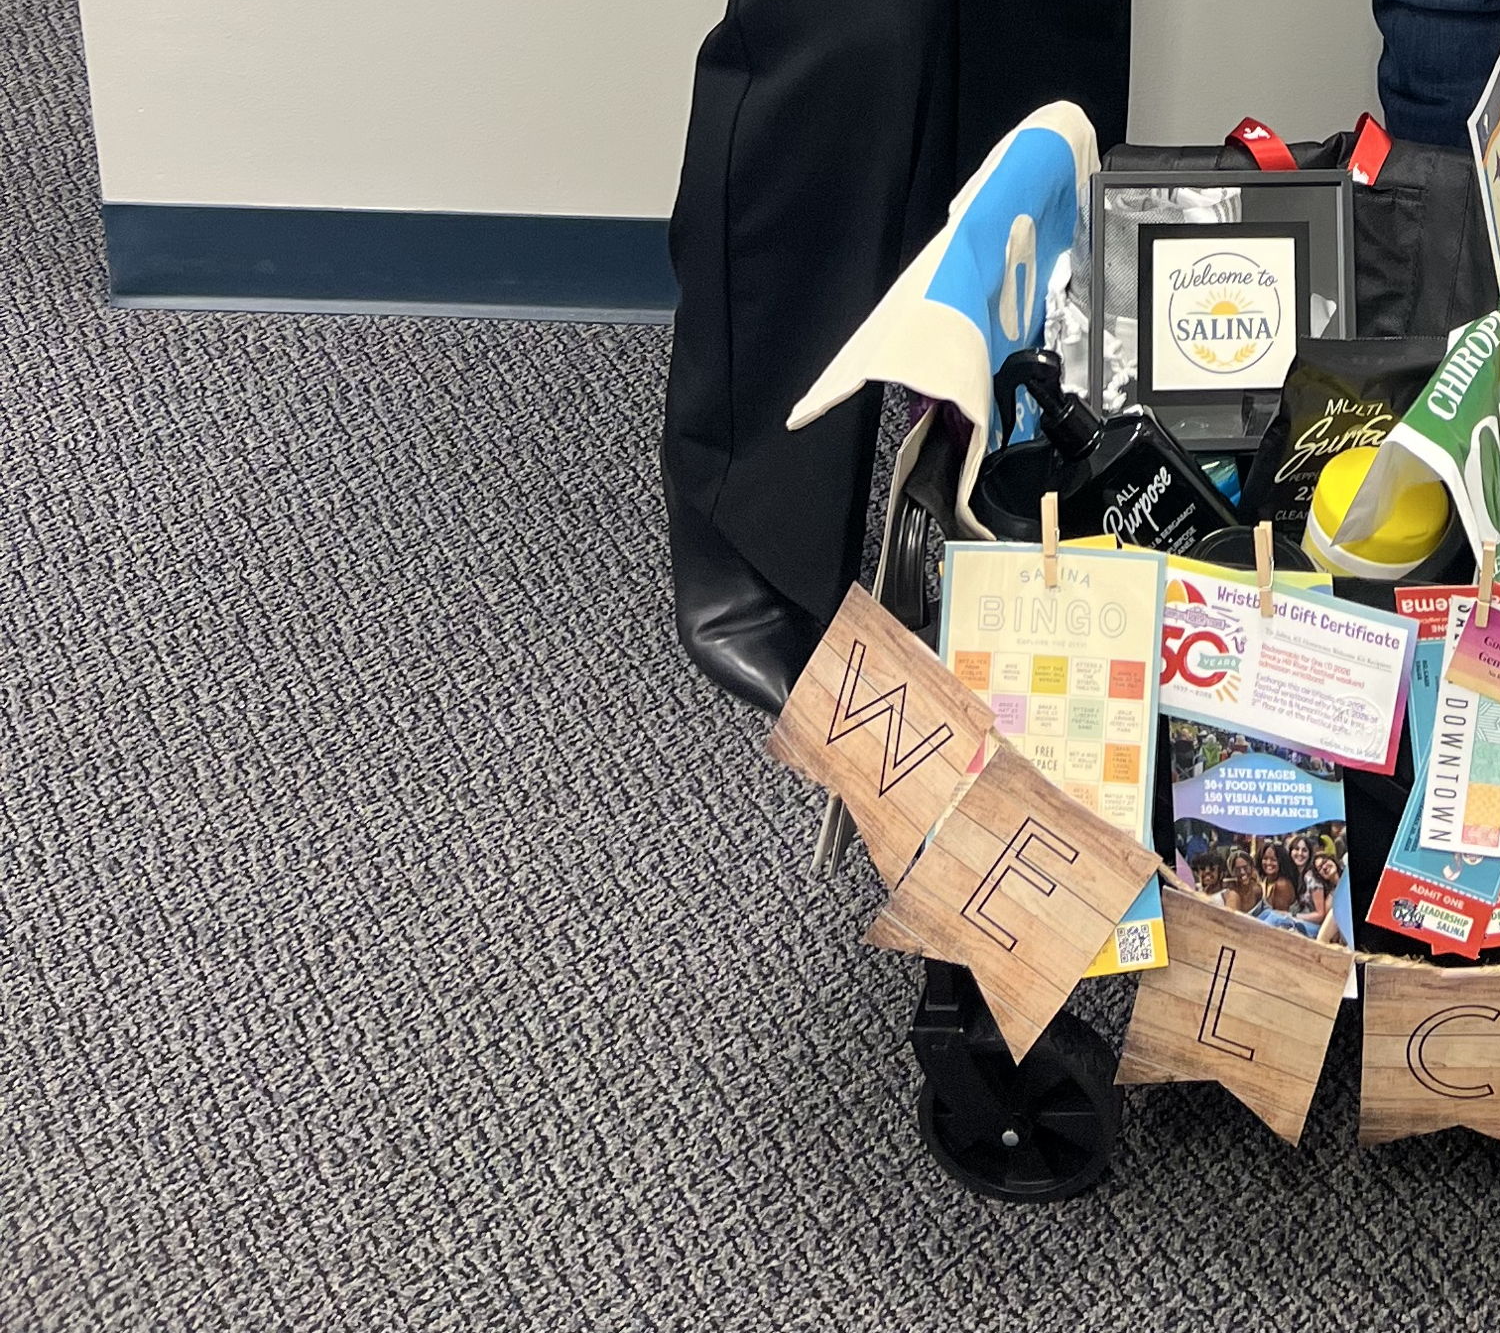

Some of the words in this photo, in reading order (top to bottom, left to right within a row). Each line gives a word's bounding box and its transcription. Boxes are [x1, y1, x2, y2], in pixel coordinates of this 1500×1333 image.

[1169, 263, 1253, 290] Welcome
[1258, 269, 1277, 286] to
[1177, 318, 1273, 341] SALINA
[1324, 399, 1383, 416] MULTI
[1274, 415, 1393, 483] Surfa
[1116, 484, 1140, 506] ALL
[1103, 466, 1171, 549] Purpose
[1160, 503, 1196, 538] BERGAMOT
[1020, 568, 1090, 588] SAINA
[978, 595, 1128, 639] BINGO
[1217, 586, 1286, 617] Wristbnd
[1290, 605, 1317, 626] Gift
[1320, 614, 1400, 650] Certificate
[1035, 746, 1054, 758] FREE
[1219, 768, 1225, 777] 3
[1228, 768, 1253, 779] LIVE
[1255, 769, 1296, 780] STAGES
[1429, 697, 1469, 843] DOWNTOWN
[1225, 781, 1257, 791] FOOD
[1259, 782, 1312, 793] VENDORS
[1204, 792, 1222, 803] 150
[1225, 793, 1265, 804] VISUAL
[1268, 795, 1313, 806] ARTISTS
[1201, 805, 1225, 815] 100+
[1228, 807, 1319, 819] PERFORMANCES
[1409, 884, 1442, 902] ADMIT
[1443, 897, 1464, 910] ONE
[1419, 903, 1469, 927] LEADERSHIP
[1436, 918, 1465, 938] SALINA
